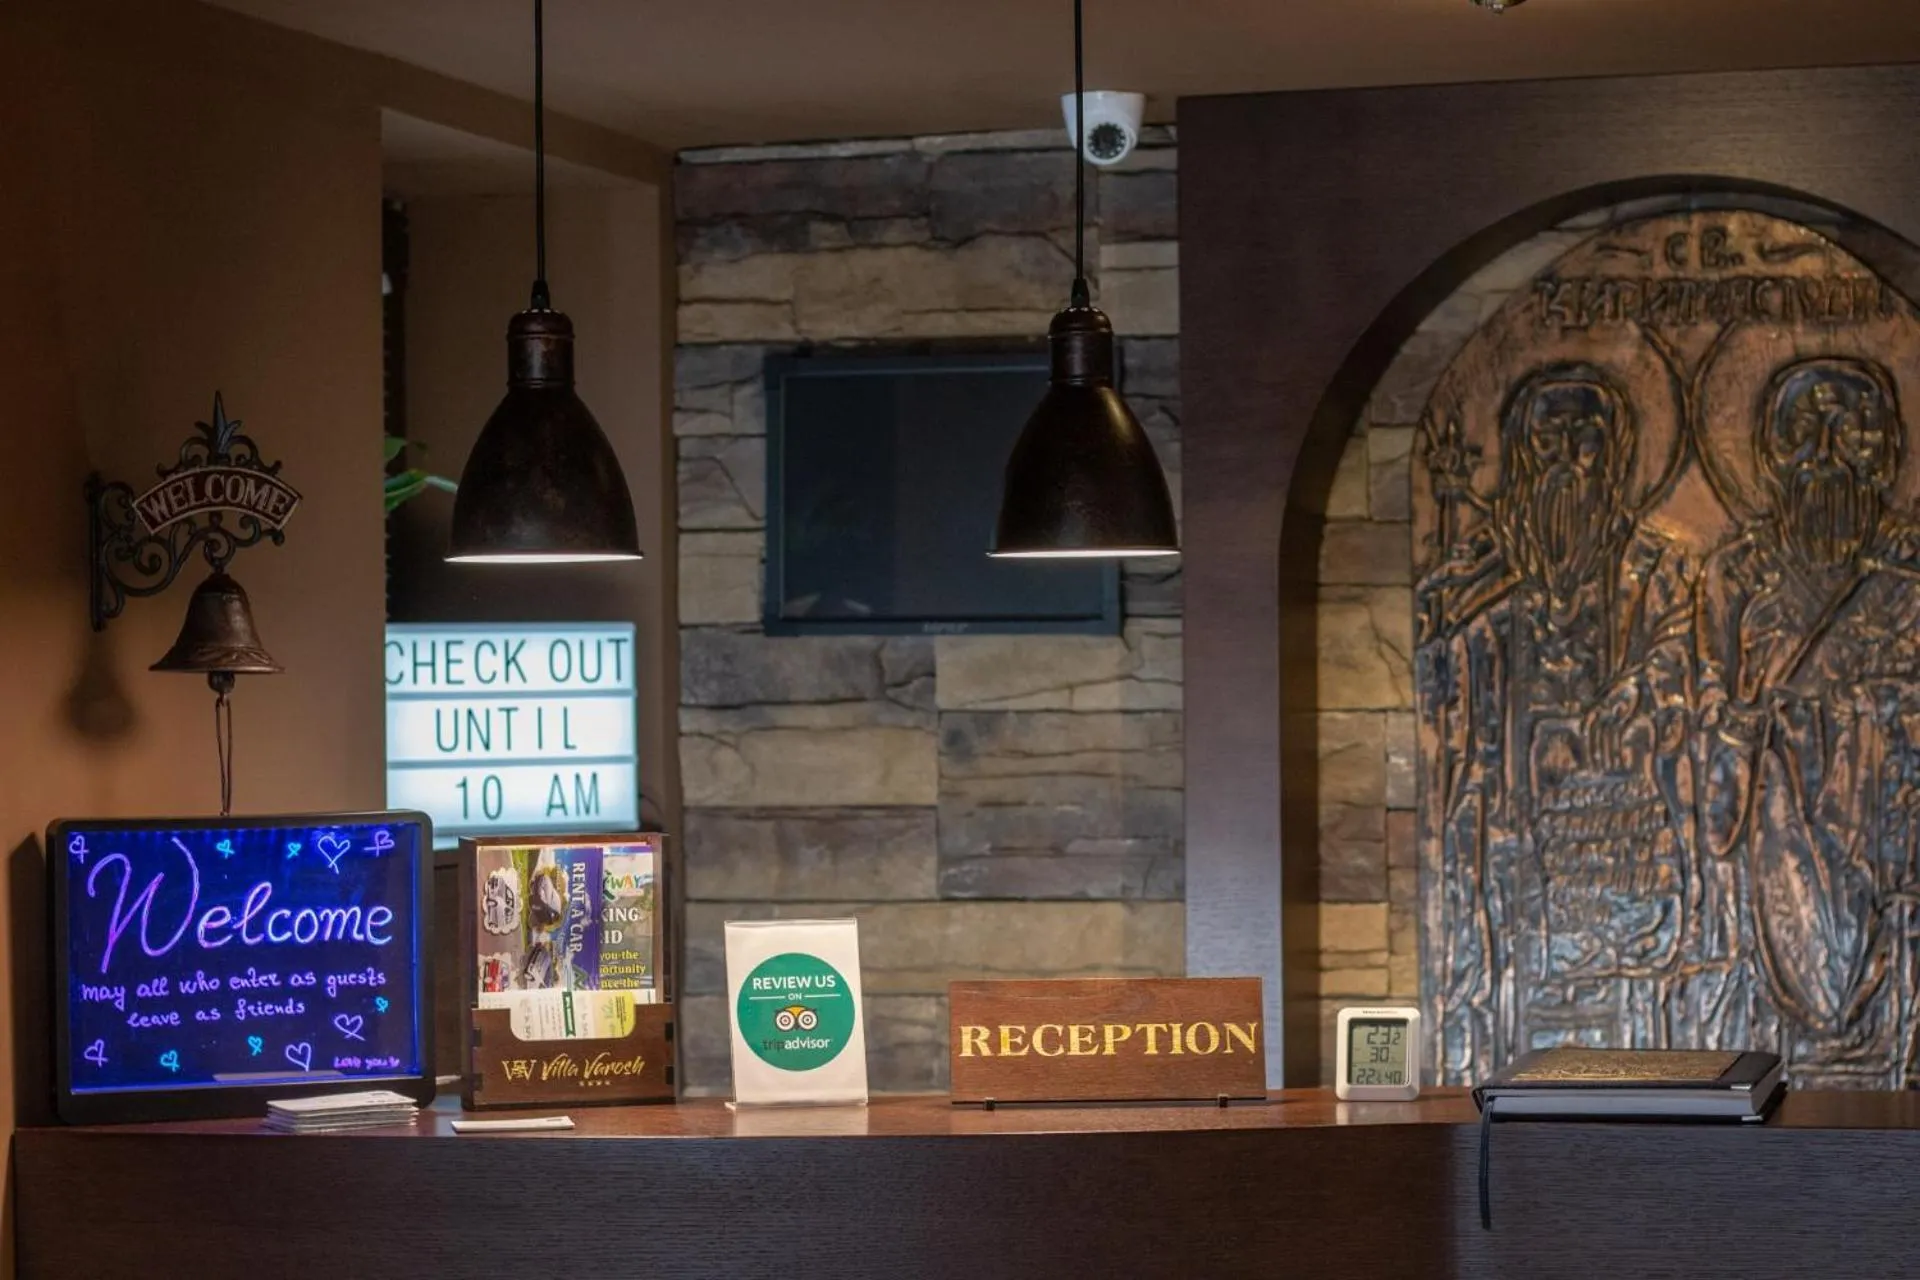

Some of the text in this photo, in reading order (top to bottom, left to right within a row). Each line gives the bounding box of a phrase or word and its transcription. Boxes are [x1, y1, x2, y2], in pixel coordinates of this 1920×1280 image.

[141, 475, 289, 523] WELCOME
[384, 638, 629, 685] CHECK OUT
[435, 706, 577, 752] UNTIL
[456, 772, 600, 820] 10 AM
[572, 862, 586, 904] RENT
[87, 837, 393, 973] Welcome
[571, 908, 584, 919] A
[569, 924, 584, 953] CAR
[600, 929, 623, 944] ID
[82, 967, 386, 1011] may all who enter as guests
[753, 975, 836, 990] REVIEW US
[788, 993, 802, 1001] ON
[126, 998, 305, 1027] leave as friends
[763, 1037, 830, 1051] tripadvisor
[959, 1021, 1257, 1058] RECEPTION
[541, 1053, 578, 1080] Villa
[584, 1052, 645, 1079] Varosh
